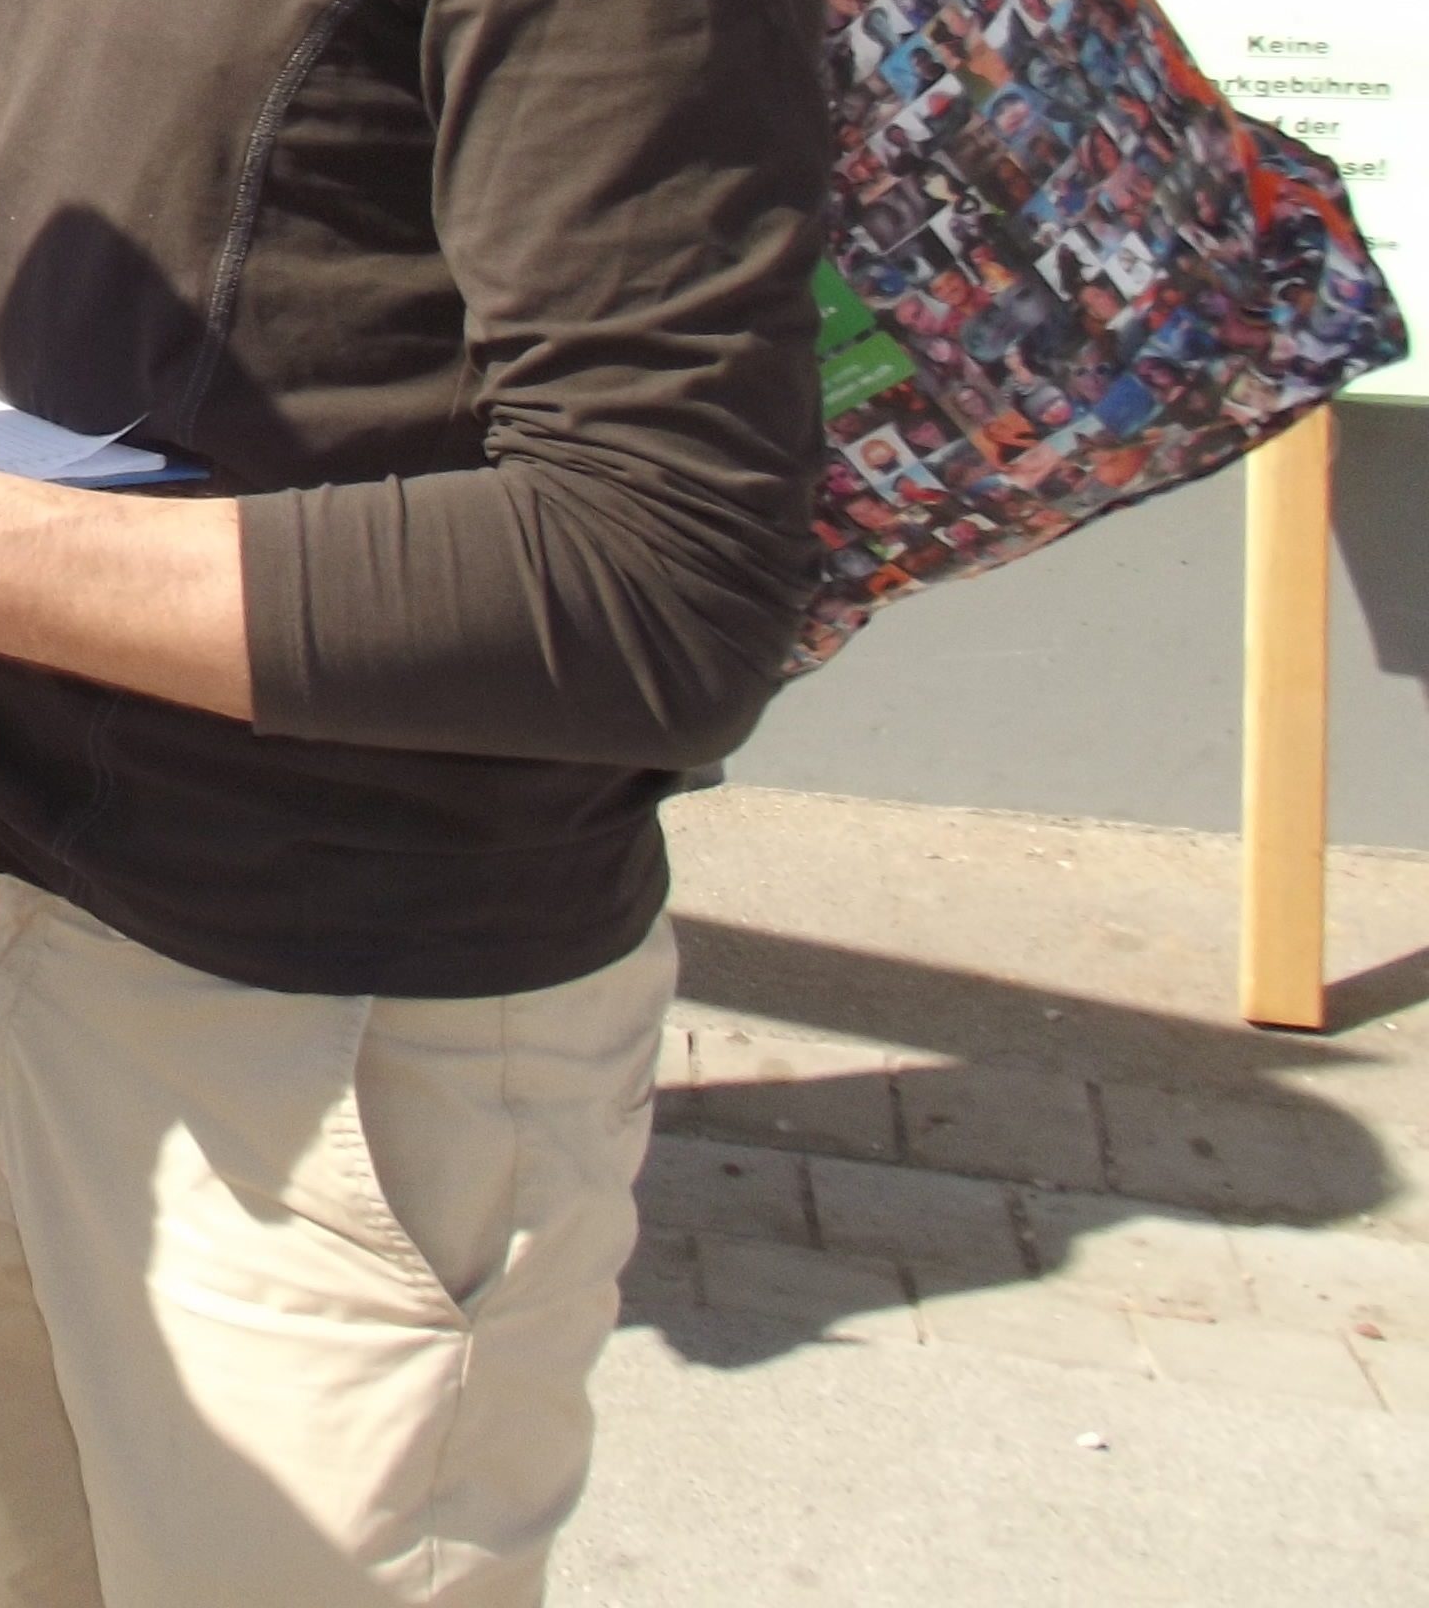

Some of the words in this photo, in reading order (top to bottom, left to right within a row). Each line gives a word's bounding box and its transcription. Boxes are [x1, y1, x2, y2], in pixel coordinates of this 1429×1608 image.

[1247, 35, 1330, 55] Keine
[1211, 75, 1391, 98] rkgebühren
[1295, 116, 1341, 135] der
